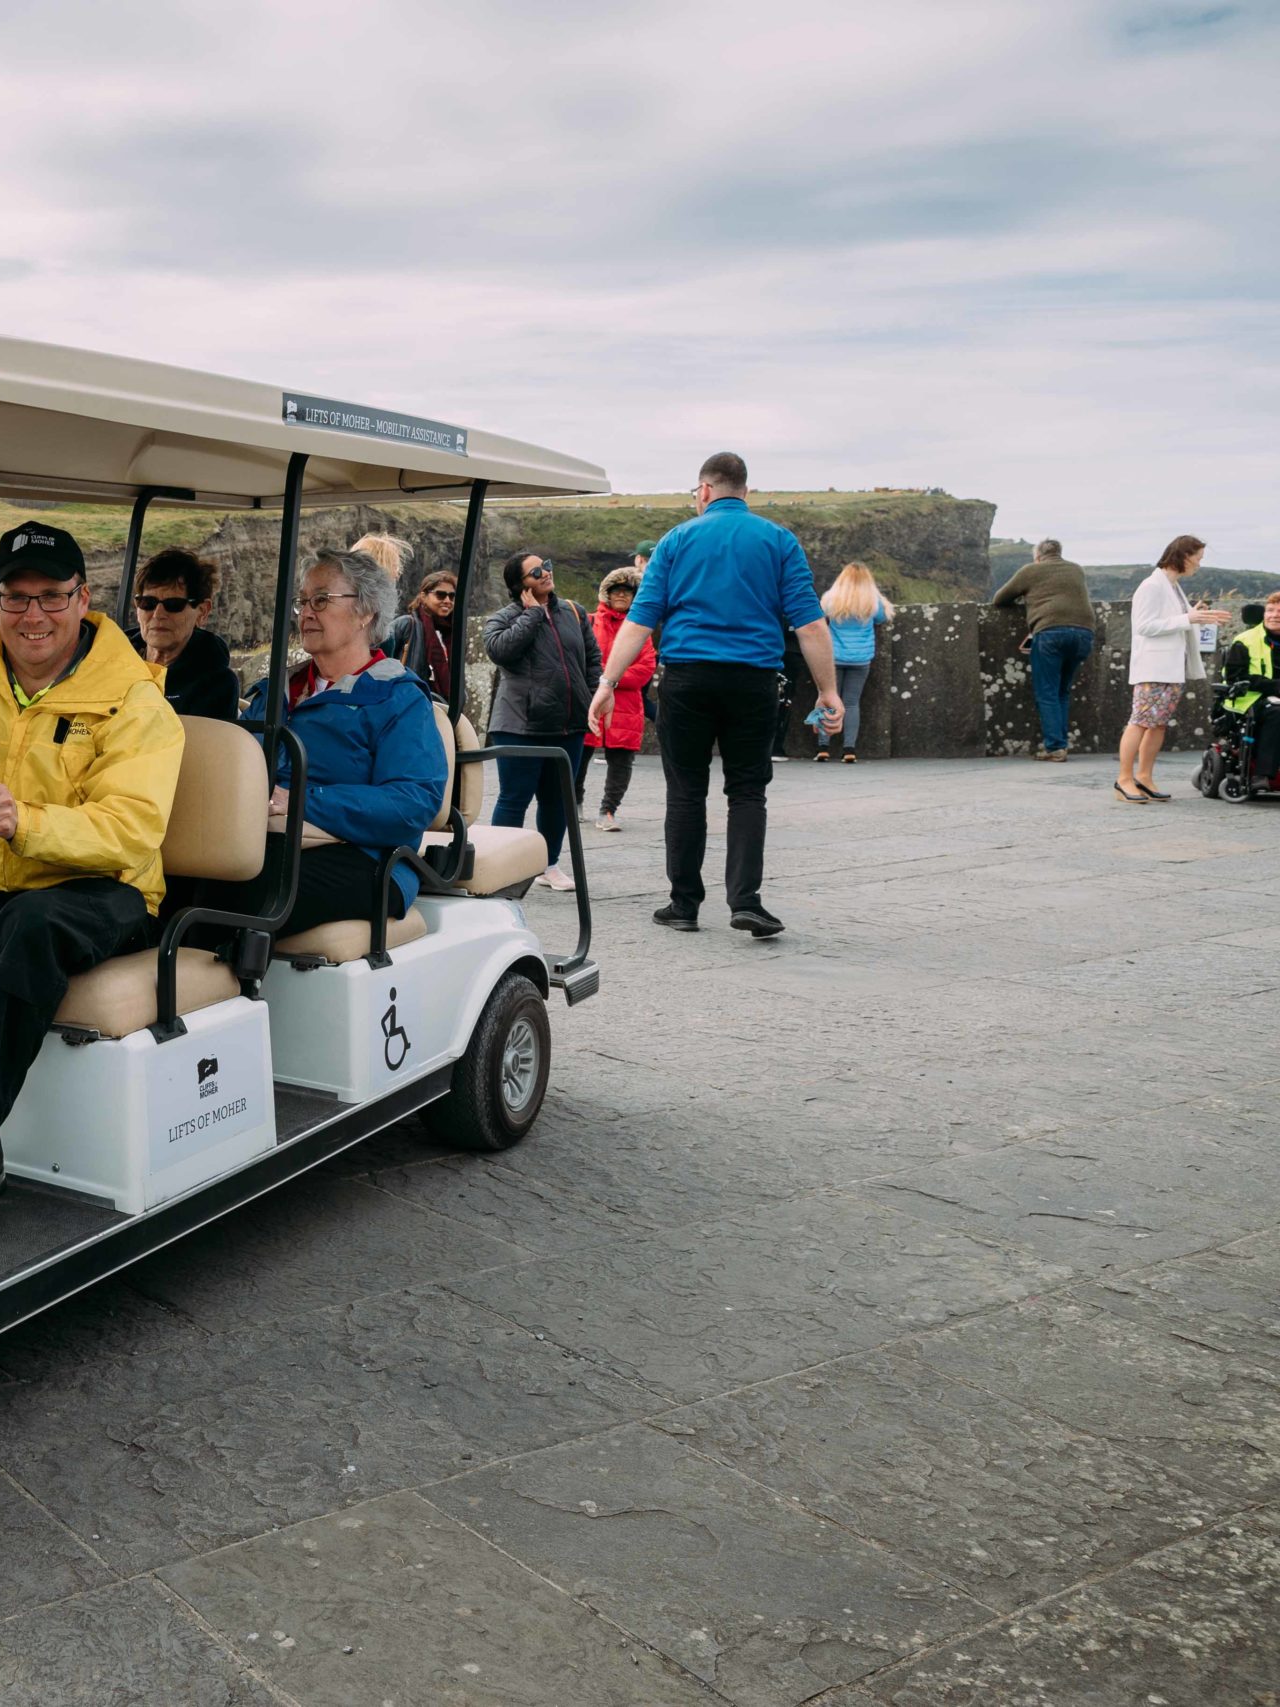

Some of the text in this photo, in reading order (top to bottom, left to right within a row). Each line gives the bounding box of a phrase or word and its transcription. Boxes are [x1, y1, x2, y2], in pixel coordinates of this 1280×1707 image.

[305, 407, 328, 424] LIFTS
[329, 411, 341, 426] OF
[341, 413, 370, 431] MOHER
[376, 420, 412, 439] MOBILITY
[410, 426, 451, 447] ASSISTANCE
[200, 1086, 218, 1099] MOHER
[168, 1097, 247, 1143] LIFTS OF MOHER
